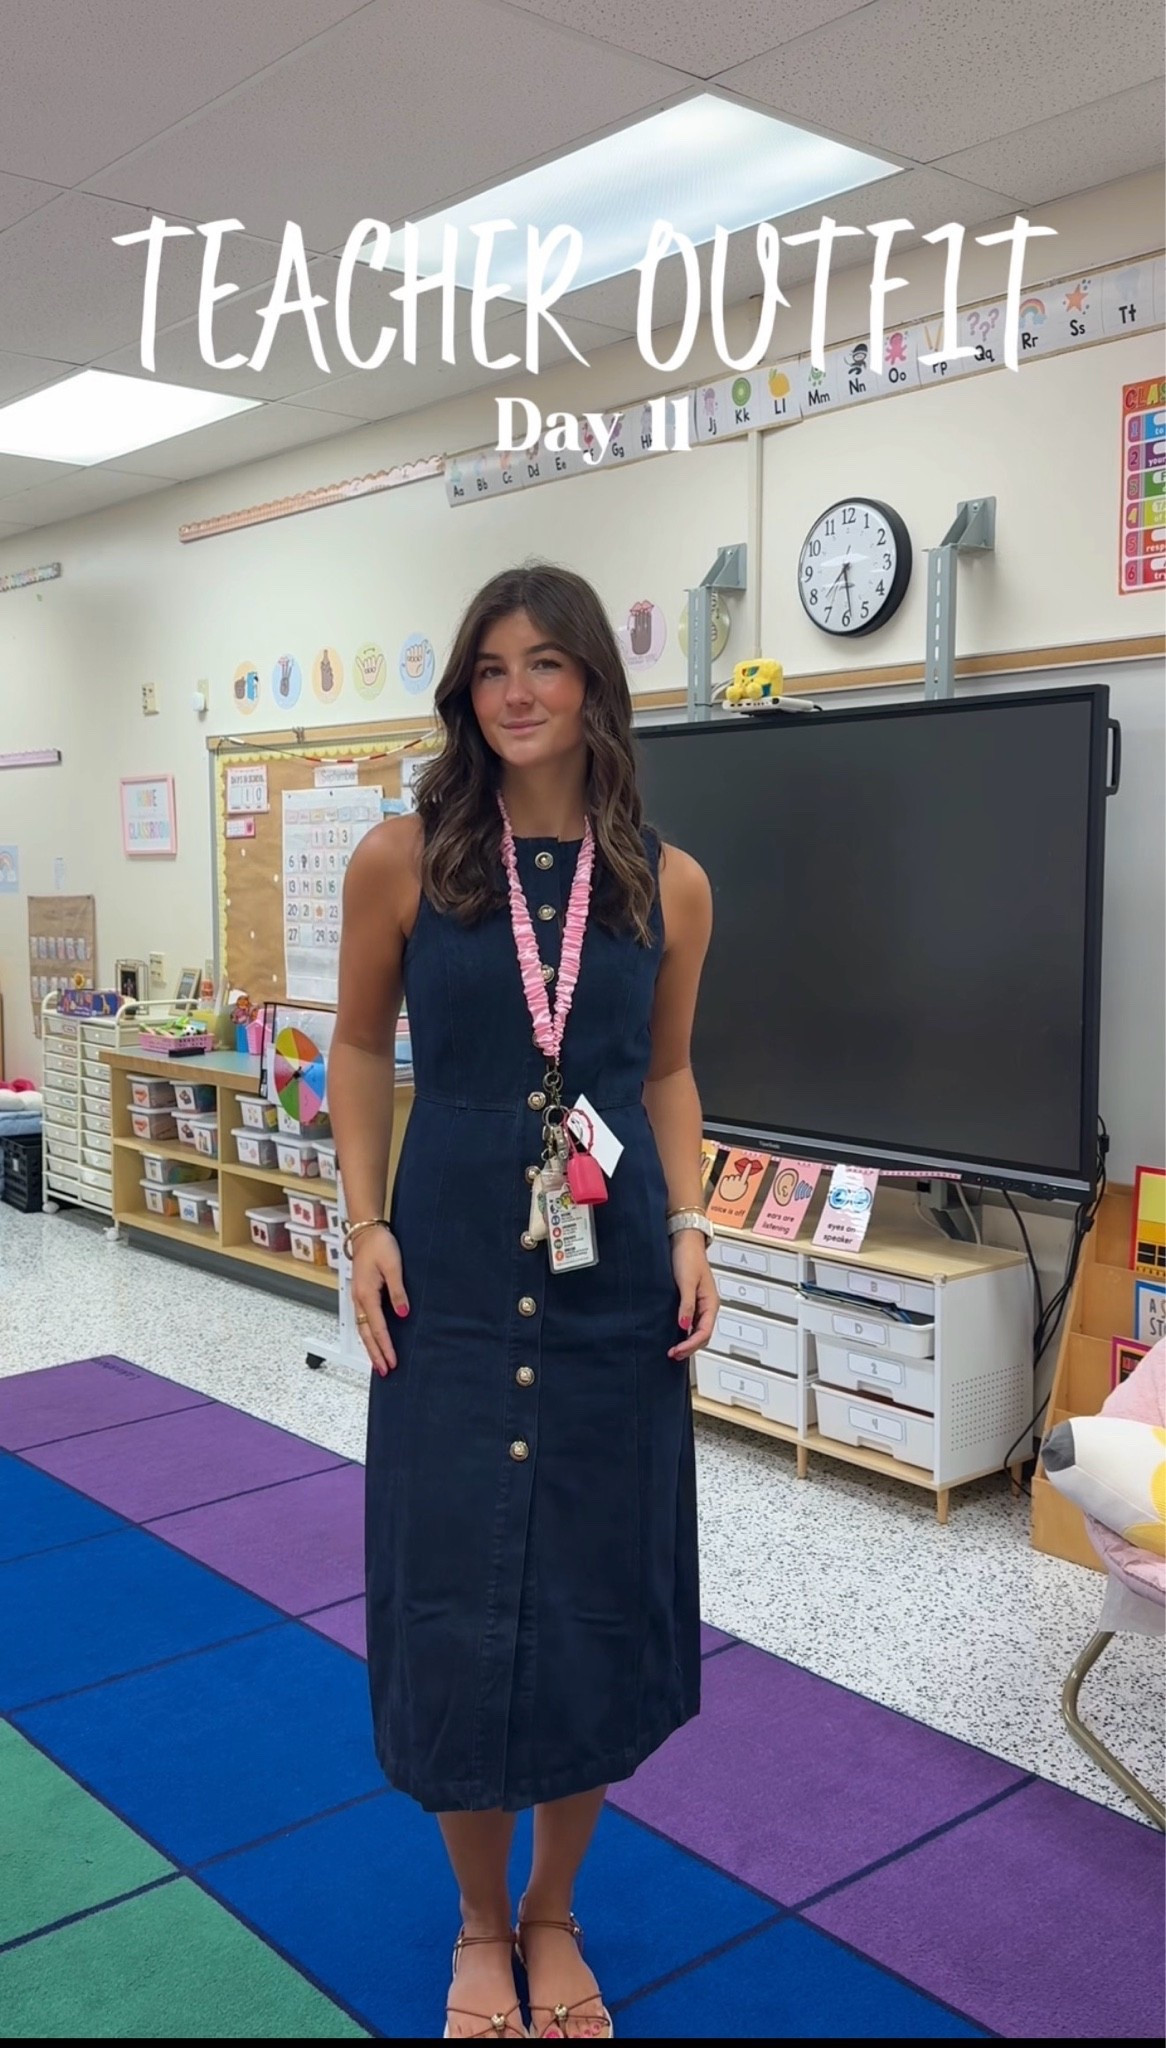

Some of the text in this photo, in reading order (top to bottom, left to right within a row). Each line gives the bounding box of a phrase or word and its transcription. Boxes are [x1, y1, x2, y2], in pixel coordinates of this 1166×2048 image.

[453, 485, 464, 497] Aa
[477, 478, 488, 492] Bb
[502, 472, 513, 484] Cc
[528, 464, 540, 477] Dd
[555, 457, 567, 471] Ee
[611, 443, 624, 458] Gg
[708, 417, 717, 435] Jj
[735, 409, 750, 424] Kk
[774, 398, 786, 414] Ll
[808, 389, 830, 406] Mm
[849, 378, 866, 395] Nn
[888, 367, 907, 383] Oo
[1021, 332, 1039, 350] Rr
[1070, 319, 1086, 337] Ss
[1118, 304, 1137, 324] Tt
[1130, 451, 1138, 466] 2
[841, 507, 857, 525] 12
[864, 513, 870, 529] 1
[1128, 507, 1138, 524] 4
[825, 519, 836, 536] 11
[877, 528, 887, 546] 2
[808, 539, 821, 557] 10
[882, 553, 892, 570] 3
[804, 566, 813, 583] 9
[1127, 566, 1136, 581] 6
[875, 579, 885, 596] 4
[809, 588, 818, 605] 8
[824, 606, 833, 624] 7
[860, 601, 869, 618] 5
[842, 609, 851, 627] 6
[328, 829, 334, 843] 2
[342, 829, 348, 843] 3
[288, 855, 295, 868] 6
[314, 855, 320, 868] 8
[329, 855, 335, 868] 9
[289, 879, 296, 893] 13
[316, 880, 322, 894] 15
[328, 880, 336, 893] 16
[287, 903, 298, 917] 20
[329, 905, 339, 919] 23
[288, 927, 339, 943] 27 29 30
[711, 1205, 727, 1213] voice
[734, 1209, 746, 1217] off
[767, 1212, 782, 1220] ears
[762, 1221, 790, 1235] listening
[827, 1223, 845, 1232] eyes
[823, 1233, 853, 1245] speaker
[740, 1253, 748, 1265] A
[738, 1286, 747, 1297] C
[870, 1281, 878, 1292] B
[1149, 1298, 1157, 1313] A
[855, 1323, 863, 1334] D
[871, 1362, 878, 1374] 2
[871, 1418, 879, 1431] 4
